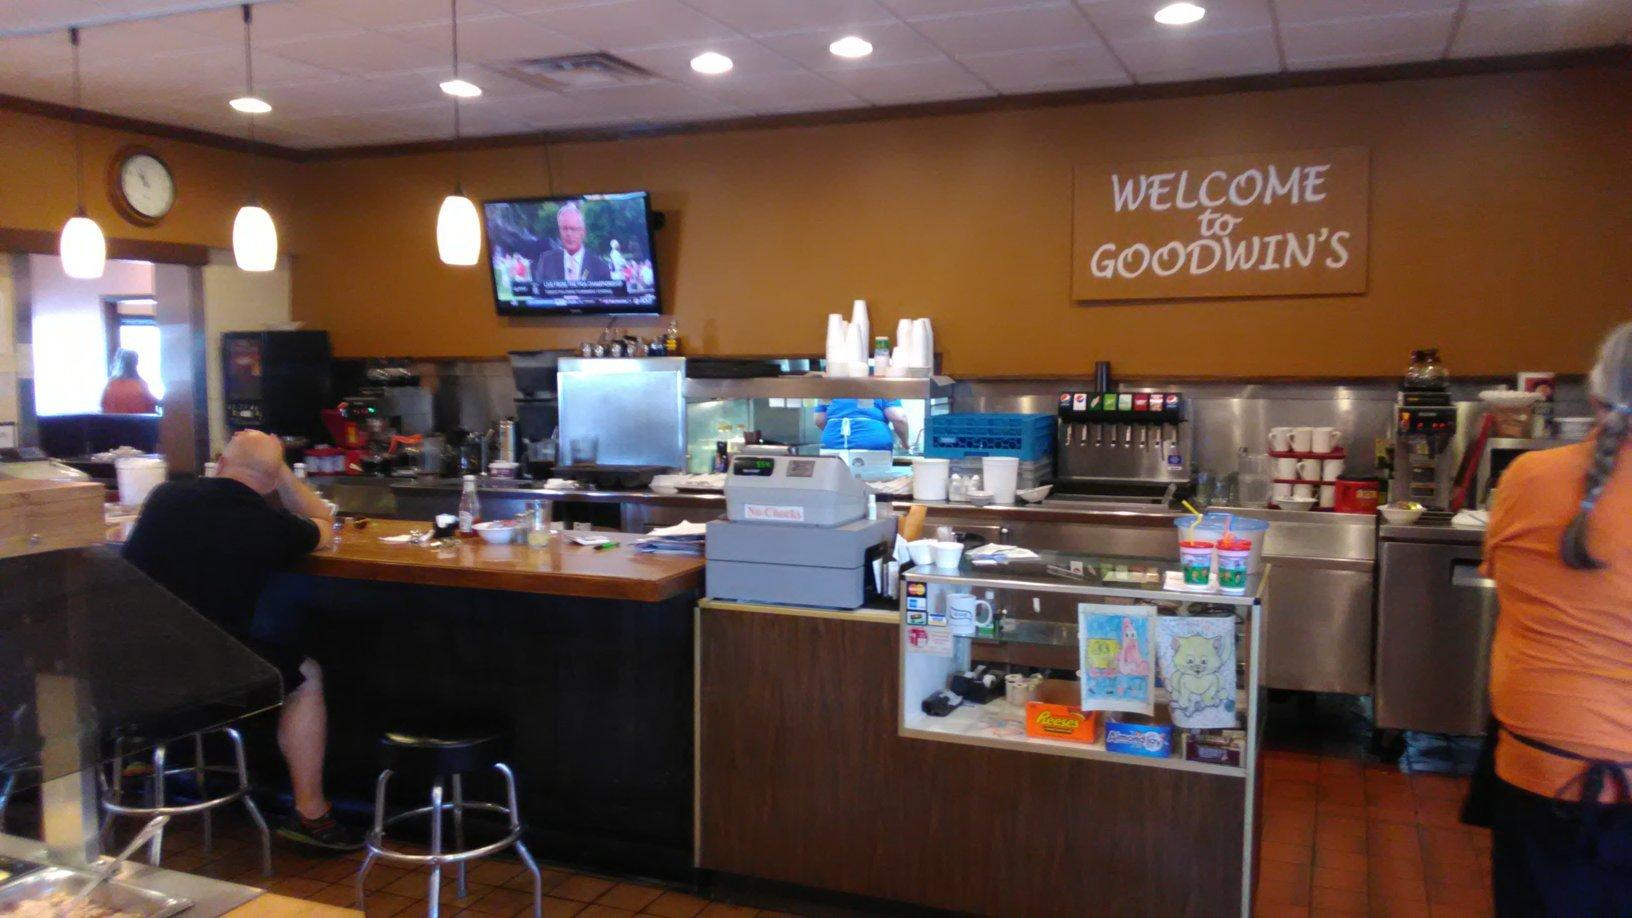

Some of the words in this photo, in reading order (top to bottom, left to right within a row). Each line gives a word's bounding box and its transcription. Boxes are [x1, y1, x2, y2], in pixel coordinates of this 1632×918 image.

[1111, 164, 1331, 213] WELCOME
[1198, 208, 1244, 237] to
[1090, 227, 1350, 279] GOODWIN'S
[747, 506, 762, 517] No
[764, 507, 802, 521] Checks
[1106, 730, 1145, 745] Almond
